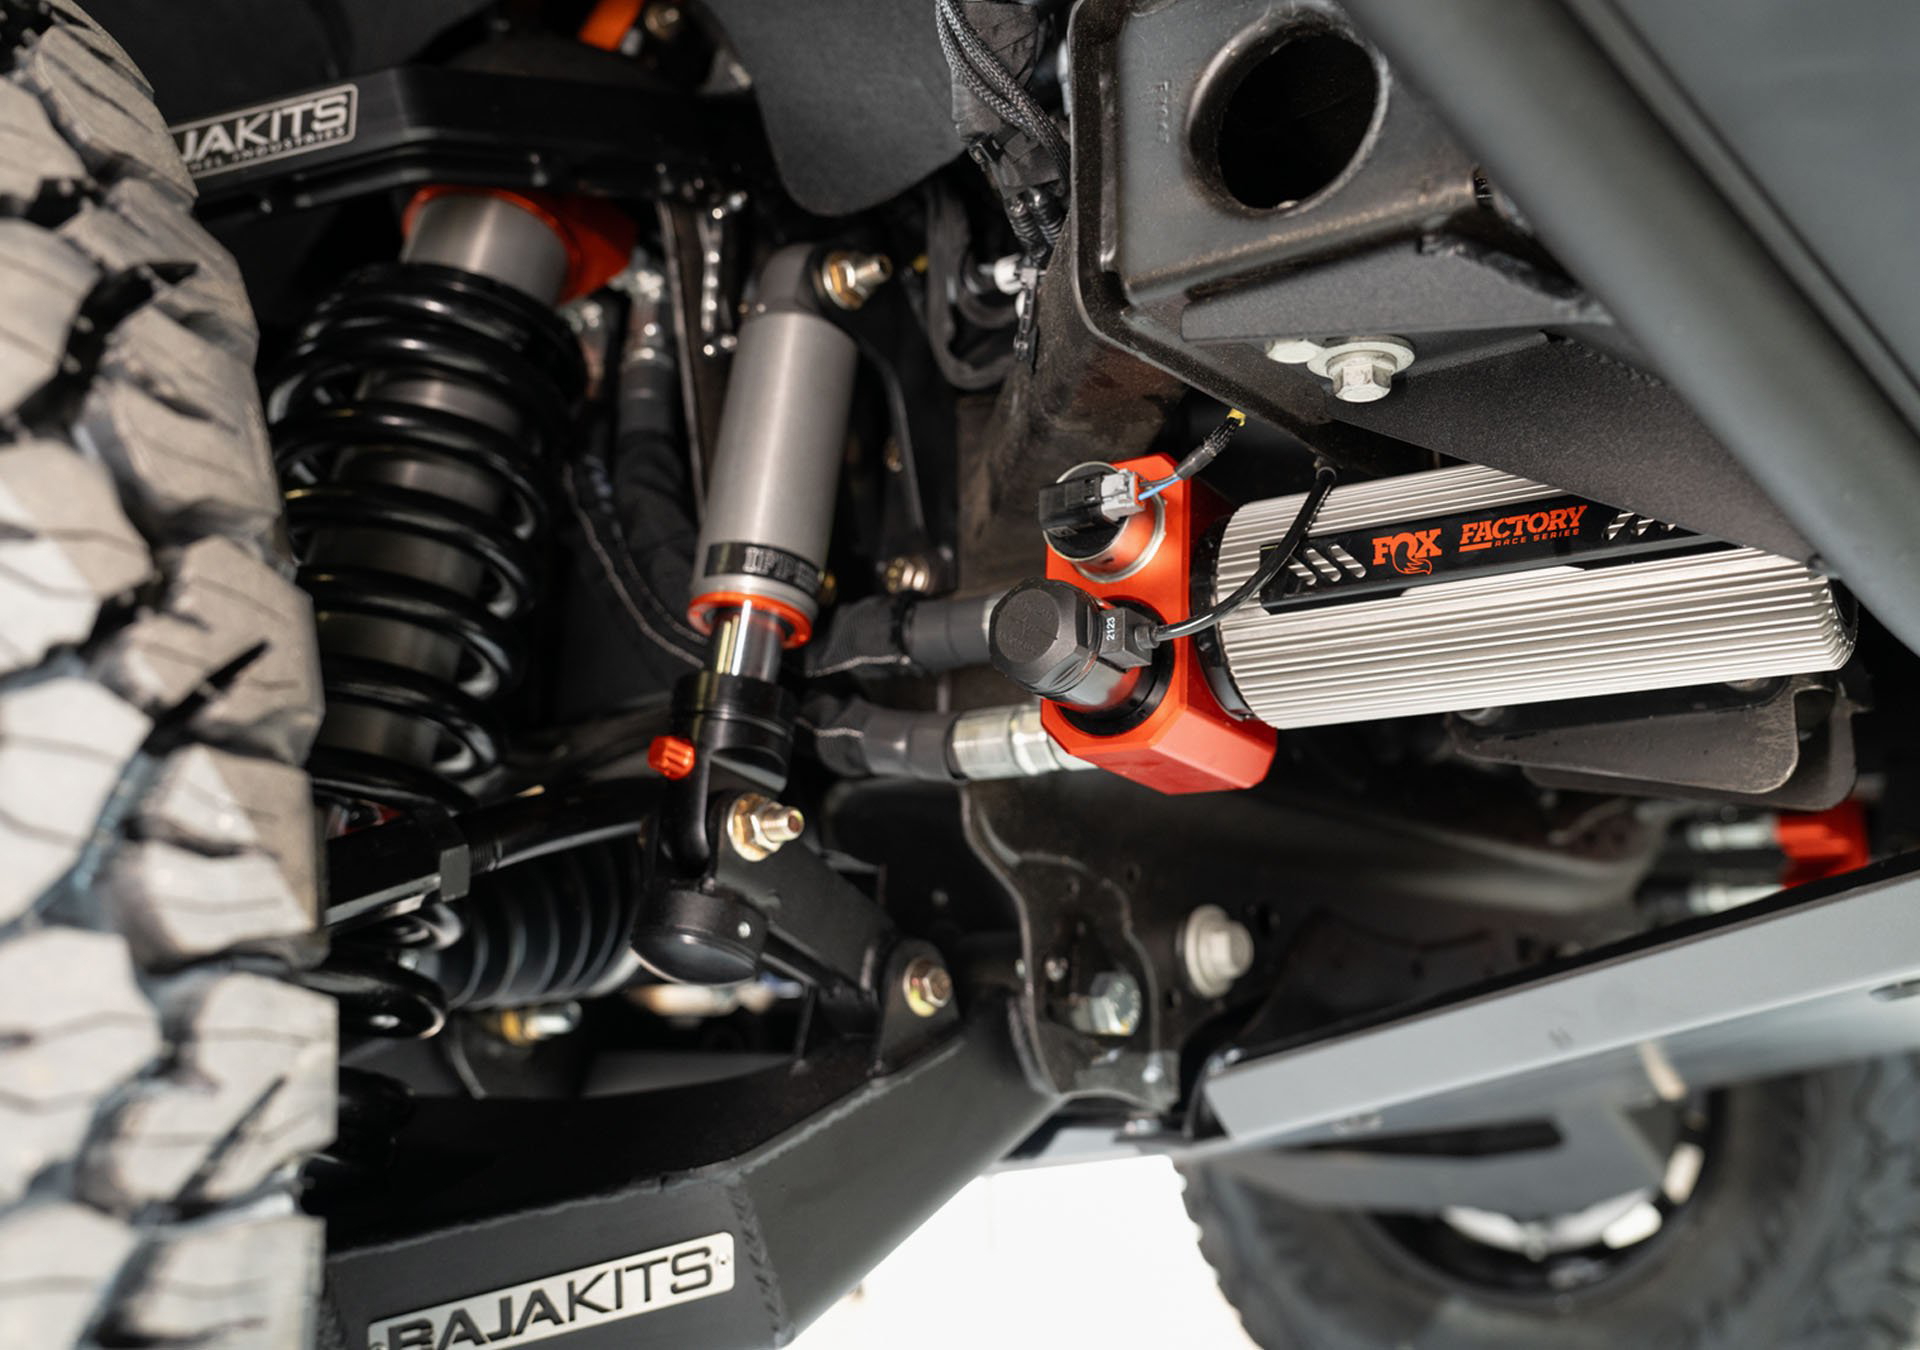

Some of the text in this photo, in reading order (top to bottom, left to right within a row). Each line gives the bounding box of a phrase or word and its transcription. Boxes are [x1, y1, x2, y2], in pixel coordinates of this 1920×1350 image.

[1459, 505, 1588, 545] FACTORY
[1495, 528, 1580, 548] RACE SERIES
[1372, 528, 1443, 574] FOX
[1106, 616, 1116, 641] 2123
